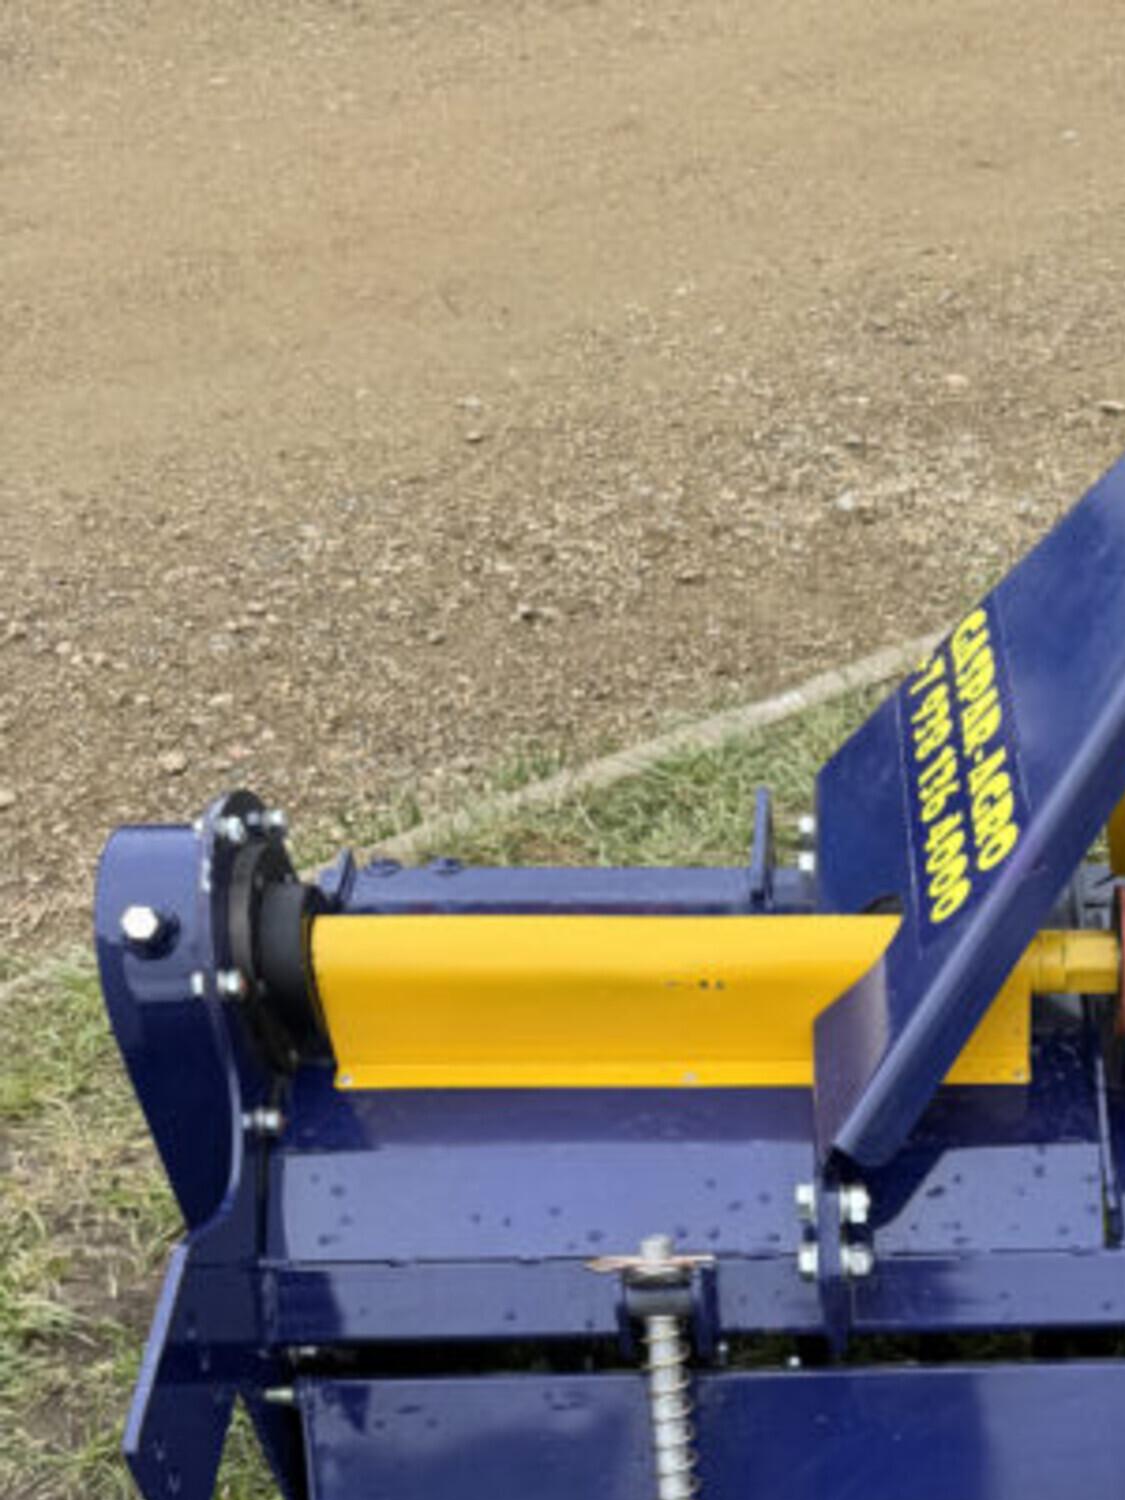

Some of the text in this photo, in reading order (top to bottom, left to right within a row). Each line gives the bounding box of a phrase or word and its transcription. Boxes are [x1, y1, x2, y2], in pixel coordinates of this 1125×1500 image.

[911, 684, 950, 760] 938
[951, 608, 1018, 871] CASPAR-AGRO
[918, 746, 960, 822] 136
[925, 812, 970, 923] 4000
